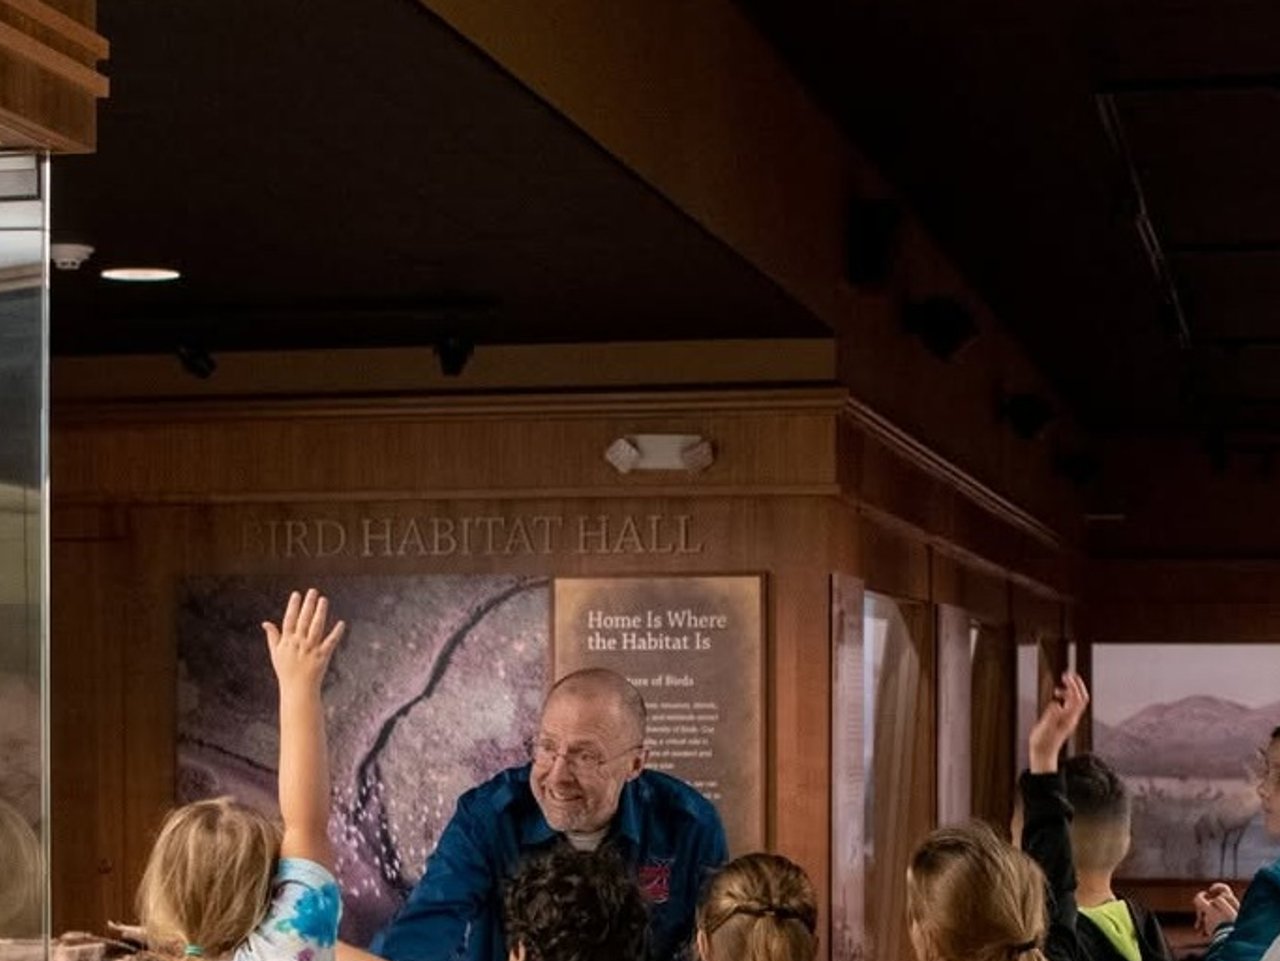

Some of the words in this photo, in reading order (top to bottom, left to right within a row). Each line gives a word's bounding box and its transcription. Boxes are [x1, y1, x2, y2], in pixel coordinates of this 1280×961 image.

[241, 518, 349, 558] BIRD
[361, 515, 563, 557] HABITAT
[578, 514, 705, 555] HALL
[587, 610, 642, 629] Home
[647, 610, 663, 629] Is
[668, 608, 728, 629] Where
[587, 632, 618, 650] the
[622, 632, 690, 650] Habitat
[695, 632, 712, 650] Is
